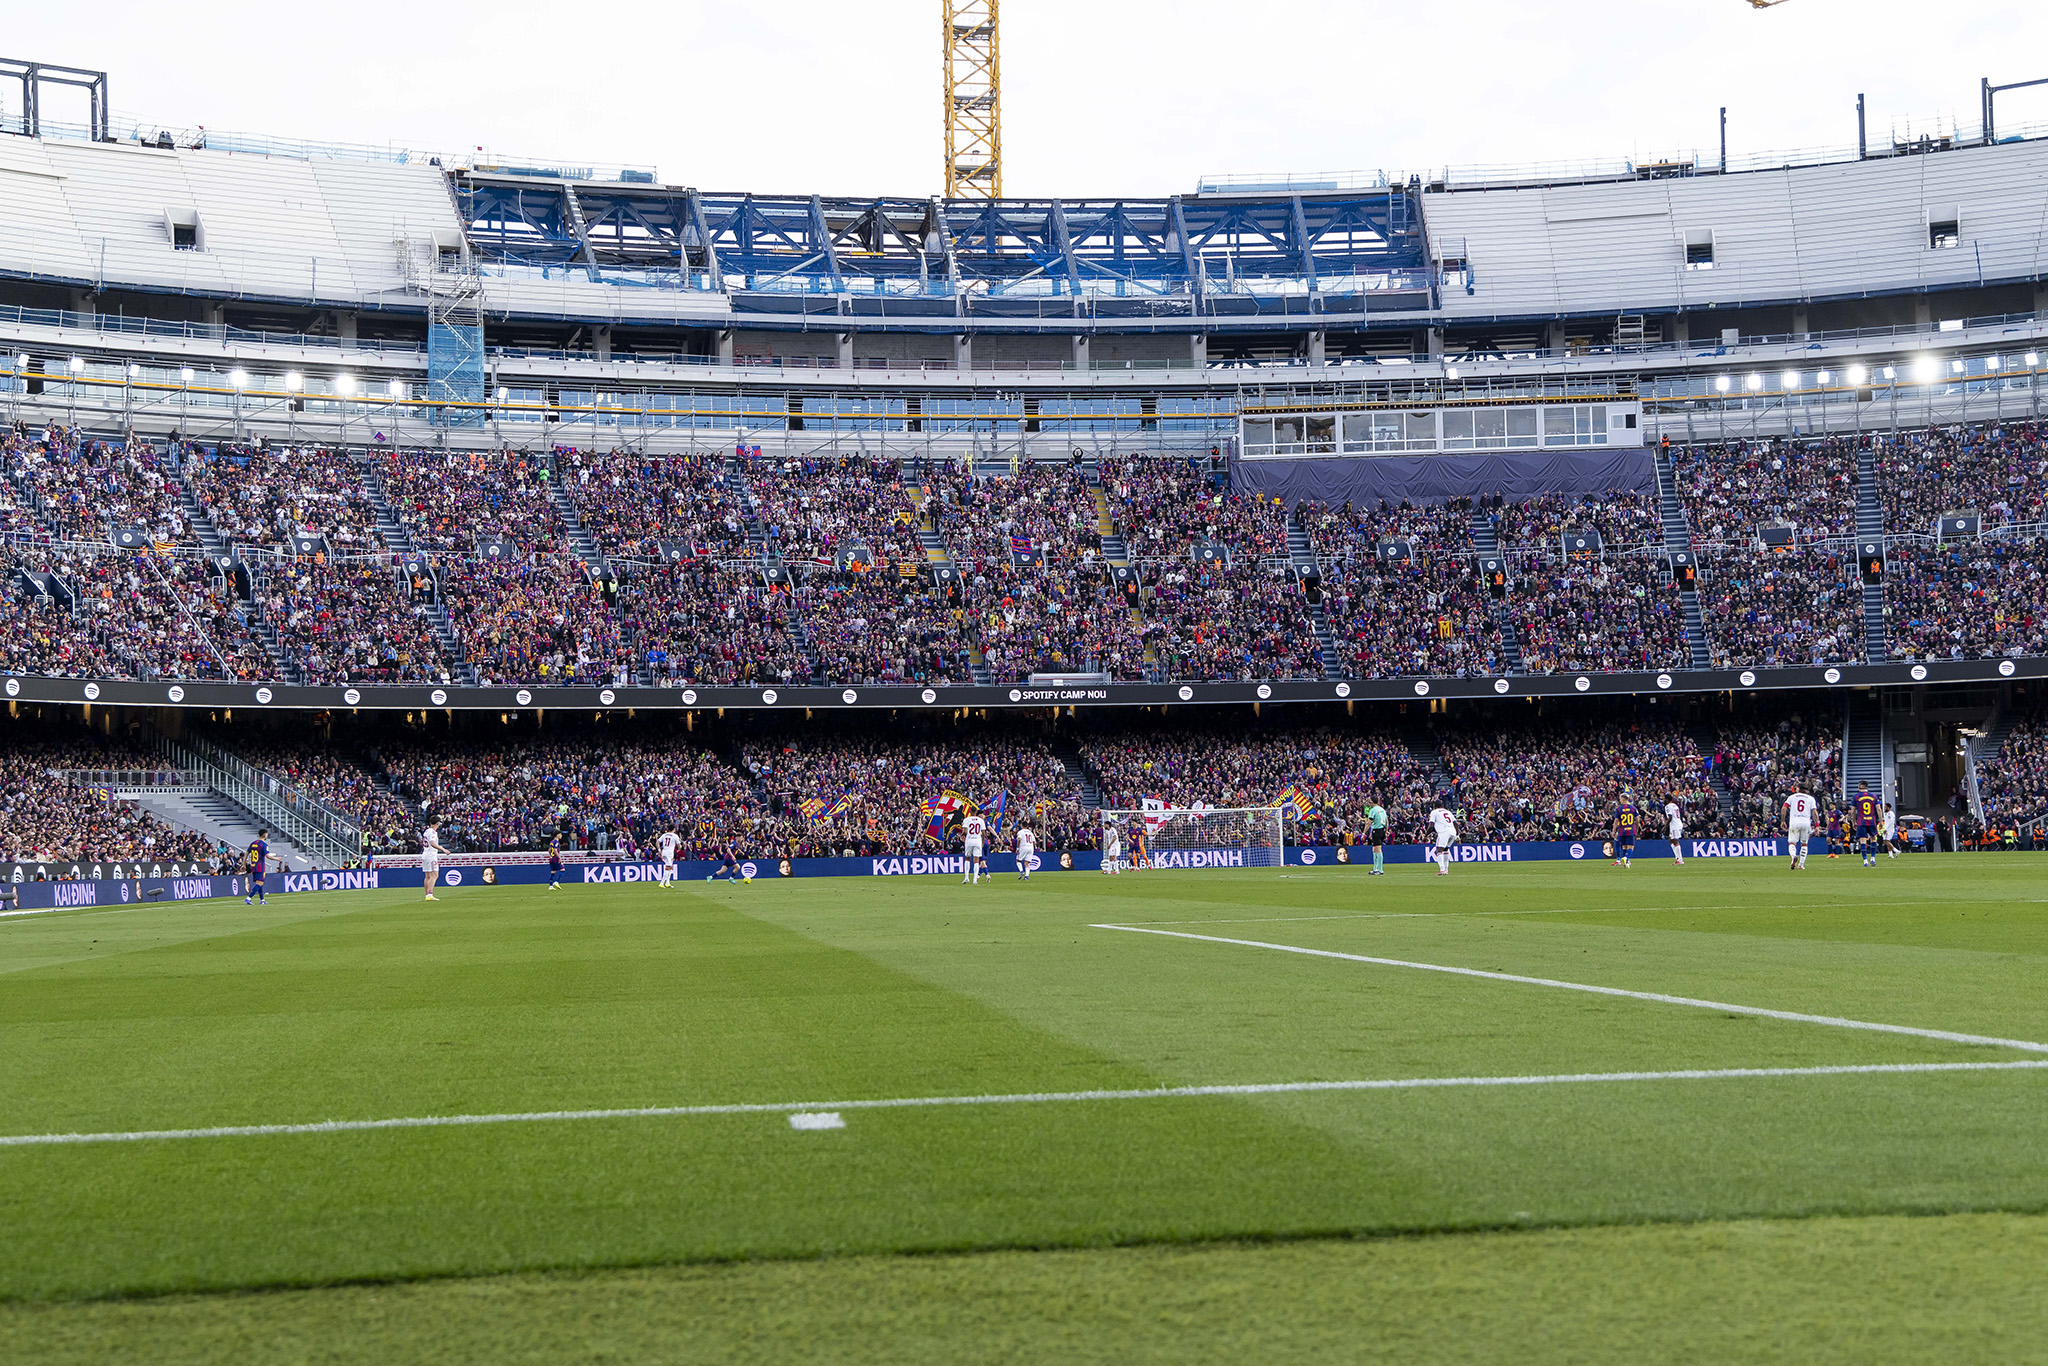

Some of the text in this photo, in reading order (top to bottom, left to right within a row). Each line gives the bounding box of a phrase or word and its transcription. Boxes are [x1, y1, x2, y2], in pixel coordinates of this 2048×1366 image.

[1022, 690, 1106, 699] SPOTIFY CAMP NOU
[1797, 799, 1805, 812] 6
[1862, 802, 1871, 815] 9
[1443, 812, 1452, 824] 5
[1620, 813, 1634, 826] 20
[968, 823, 981, 835] 20
